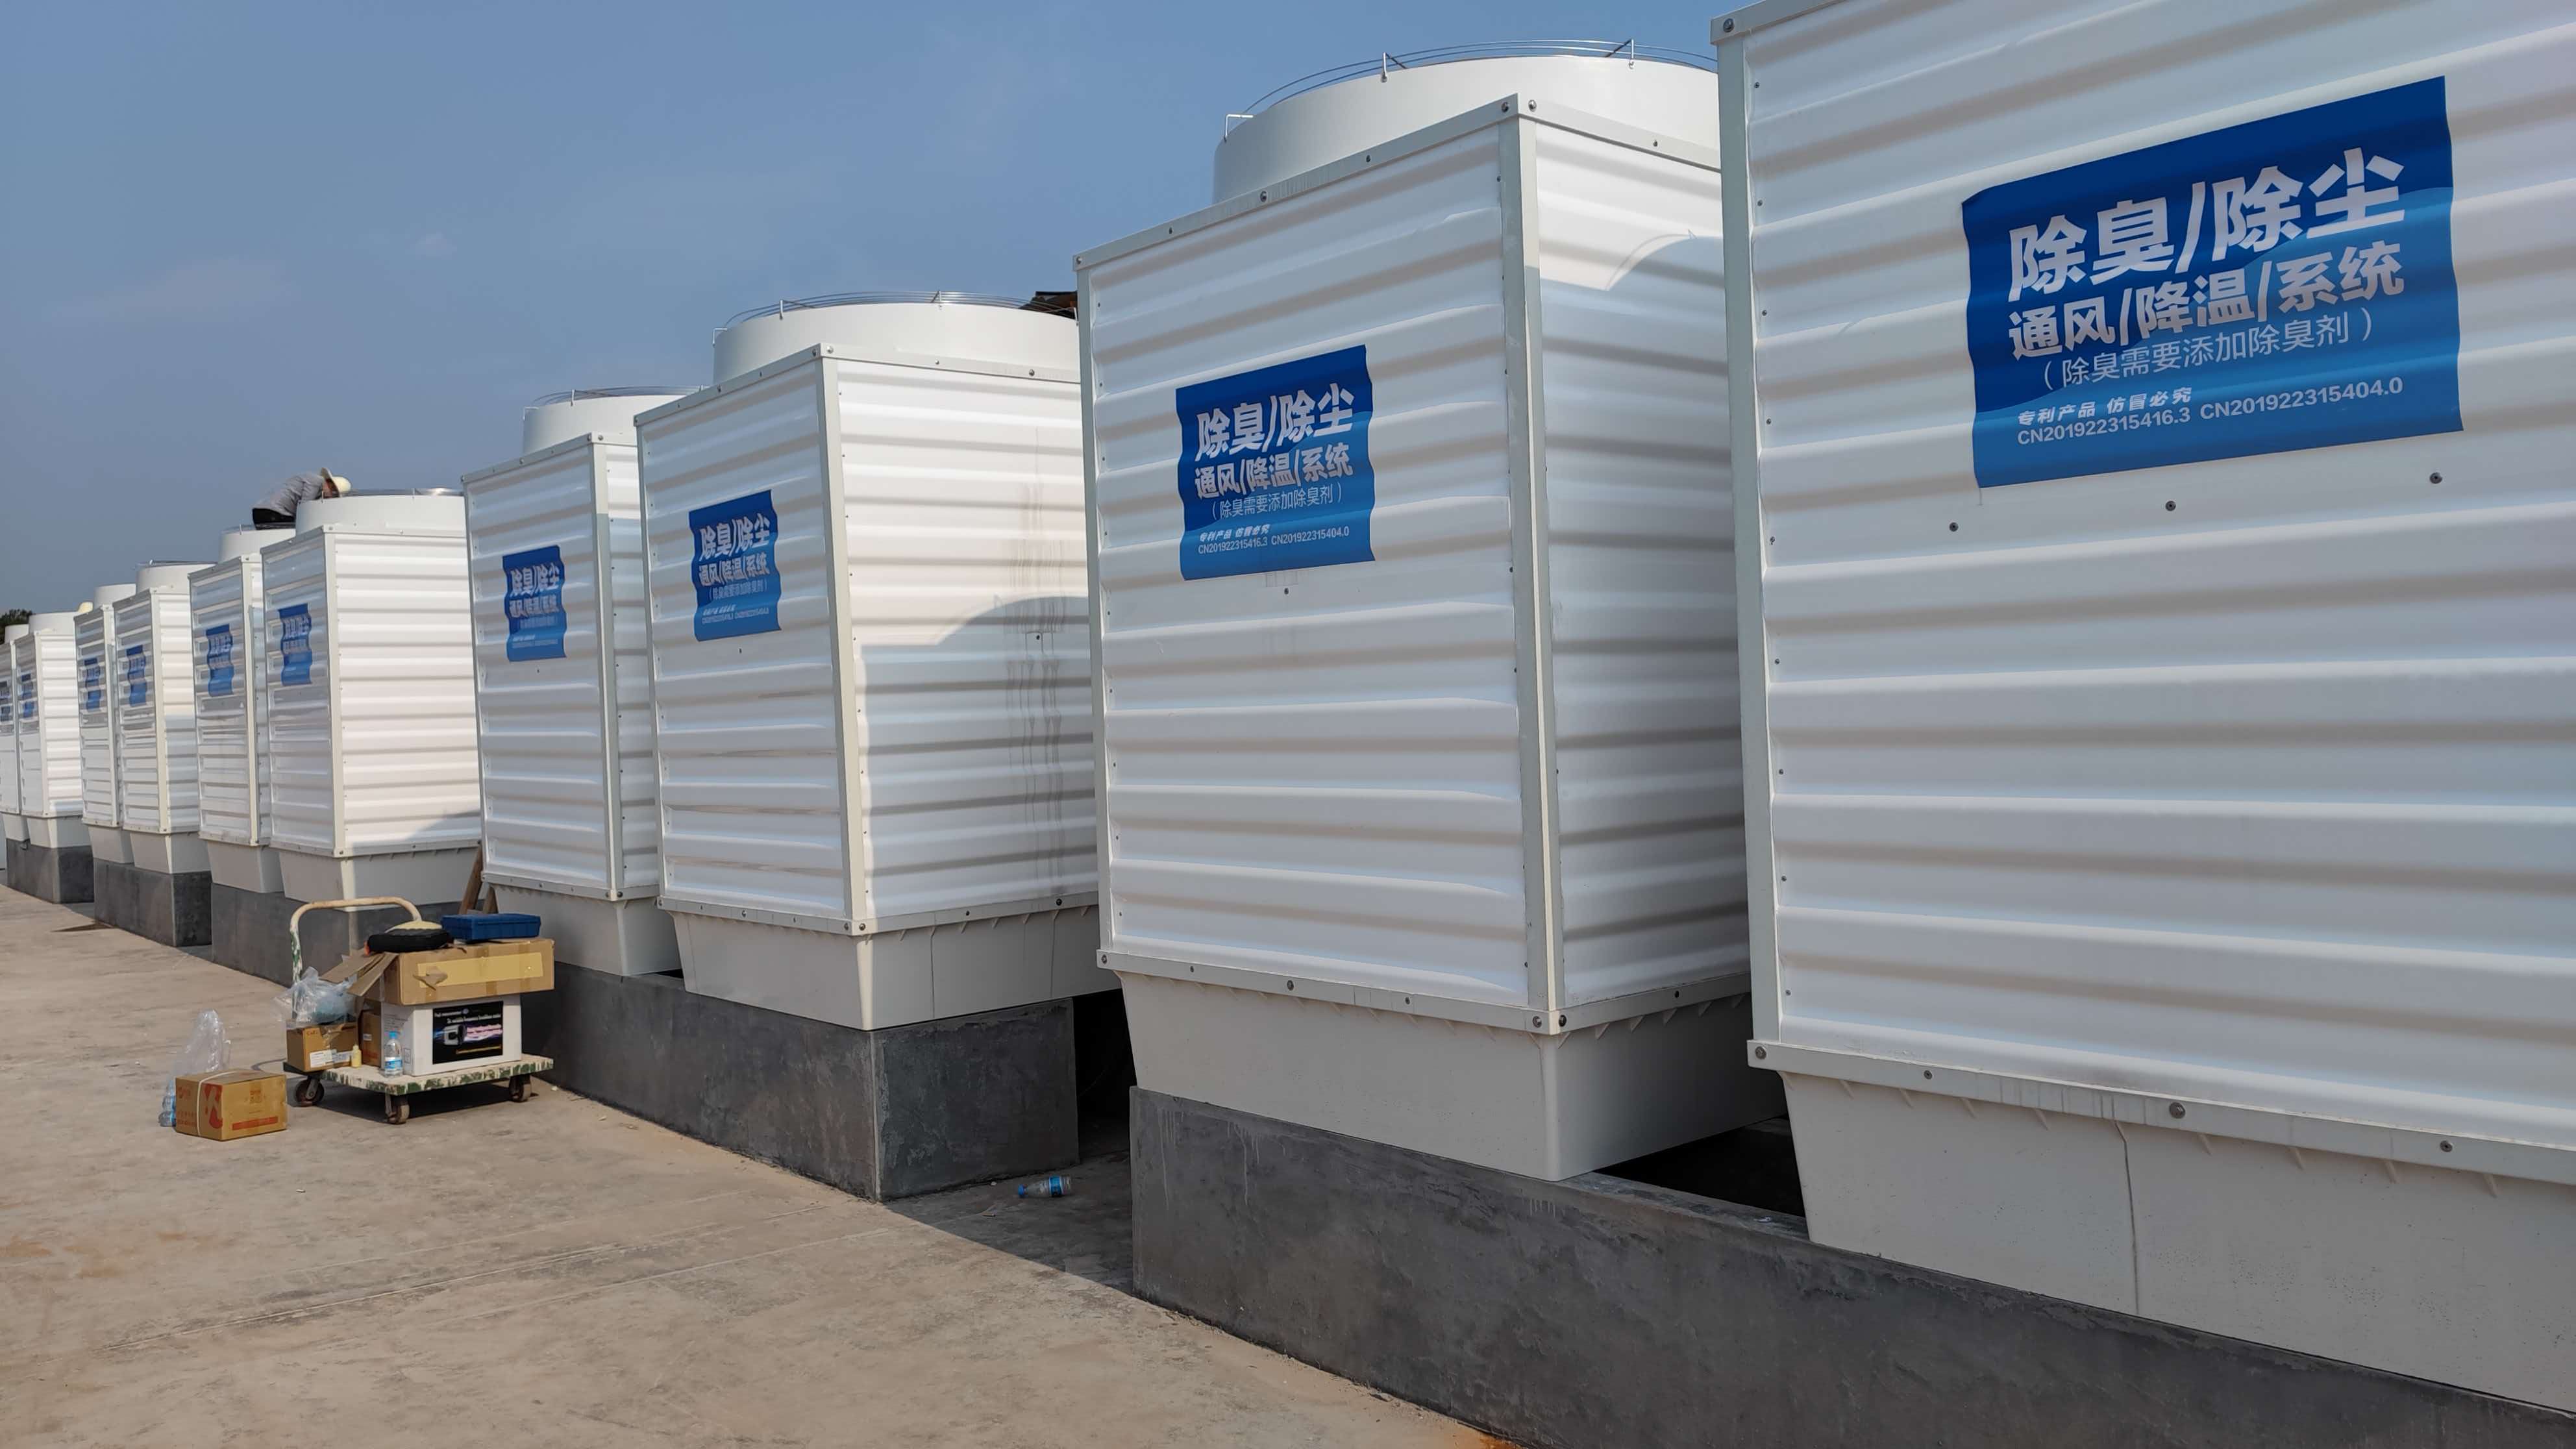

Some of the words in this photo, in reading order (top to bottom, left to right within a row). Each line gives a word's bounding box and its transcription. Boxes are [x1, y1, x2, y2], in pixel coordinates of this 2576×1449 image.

[2008, 147, 2405, 301] 除臭/除尘
[2009, 242, 2404, 360] 通风/降温/系统
[1196, 383, 1354, 462] 除臭/除尘
[2018, 400, 2096, 425] 专利产品
[2107, 386, 2192, 414] 仿冒必究
[2018, 408, 2191, 445] CN201922315416.3
[2200, 377, 2403, 420] CN201922315404.0
[1195, 443, 1354, 499] 通风/降温/系统
[699, 513, 770, 562] 除臭/除尘
[1198, 537, 1268, 554] CN201922315416.3
[1271, 526, 1350, 546] CN201922315404.0
